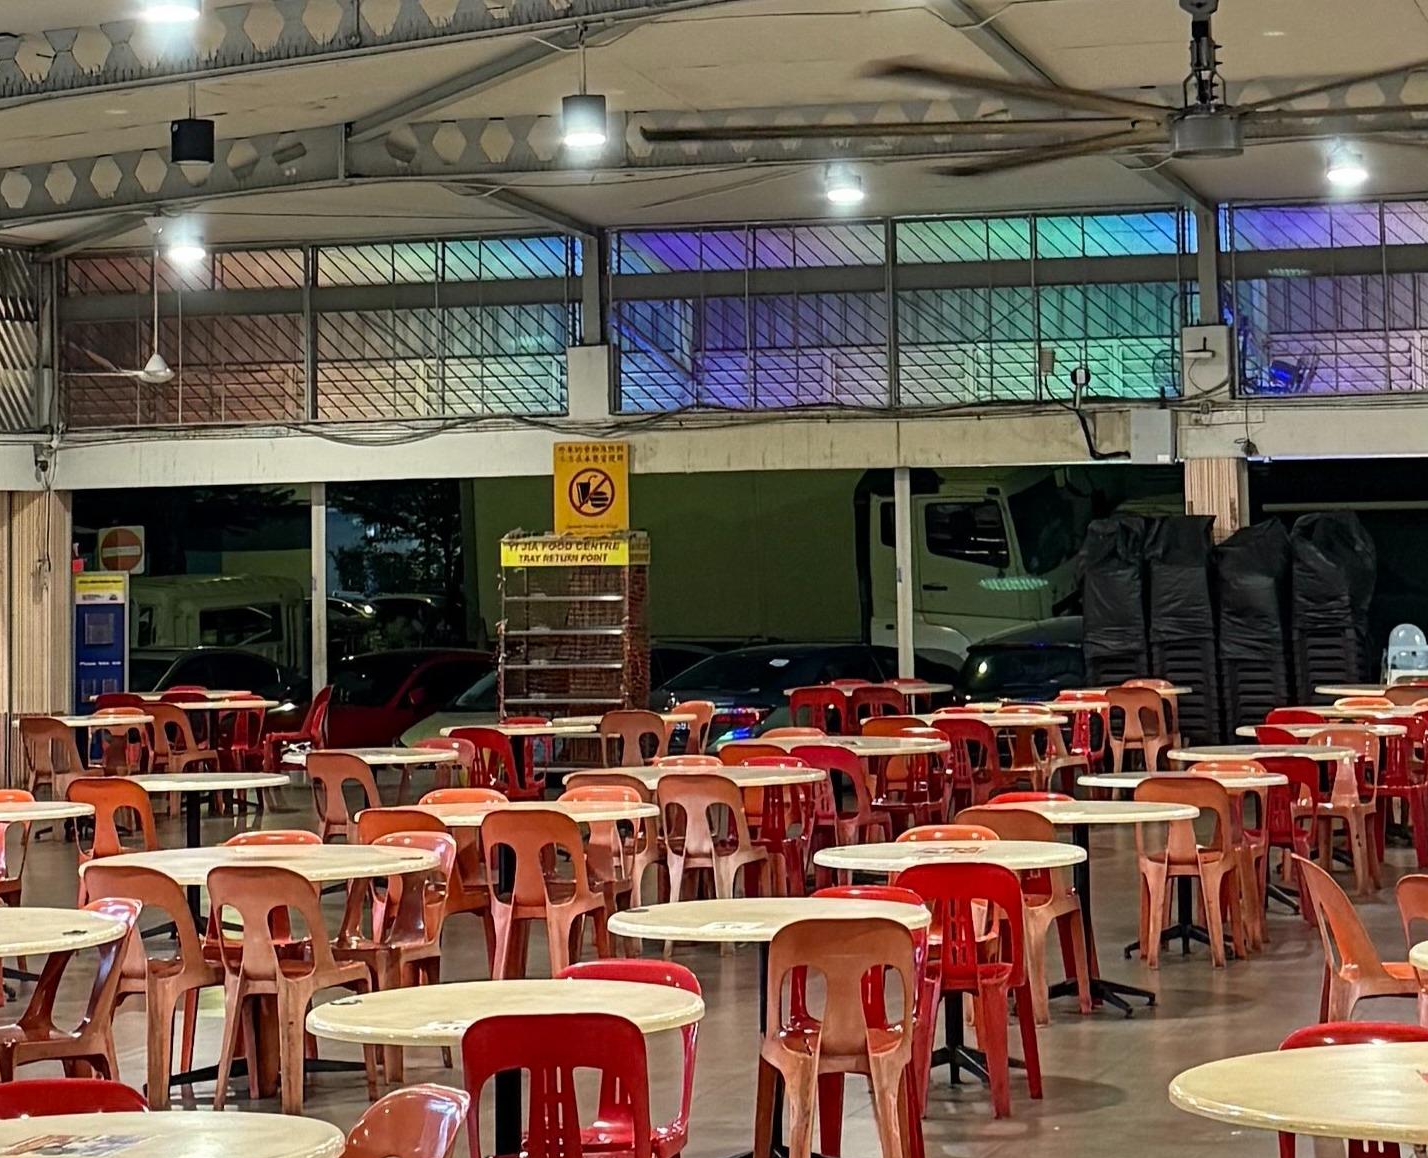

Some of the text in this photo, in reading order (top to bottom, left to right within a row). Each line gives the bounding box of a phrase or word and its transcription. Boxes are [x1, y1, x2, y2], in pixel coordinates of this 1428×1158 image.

[541, 541, 571, 551] FOOD
[519, 554, 541, 564] TRAY
[581, 553, 608, 563] POINT
